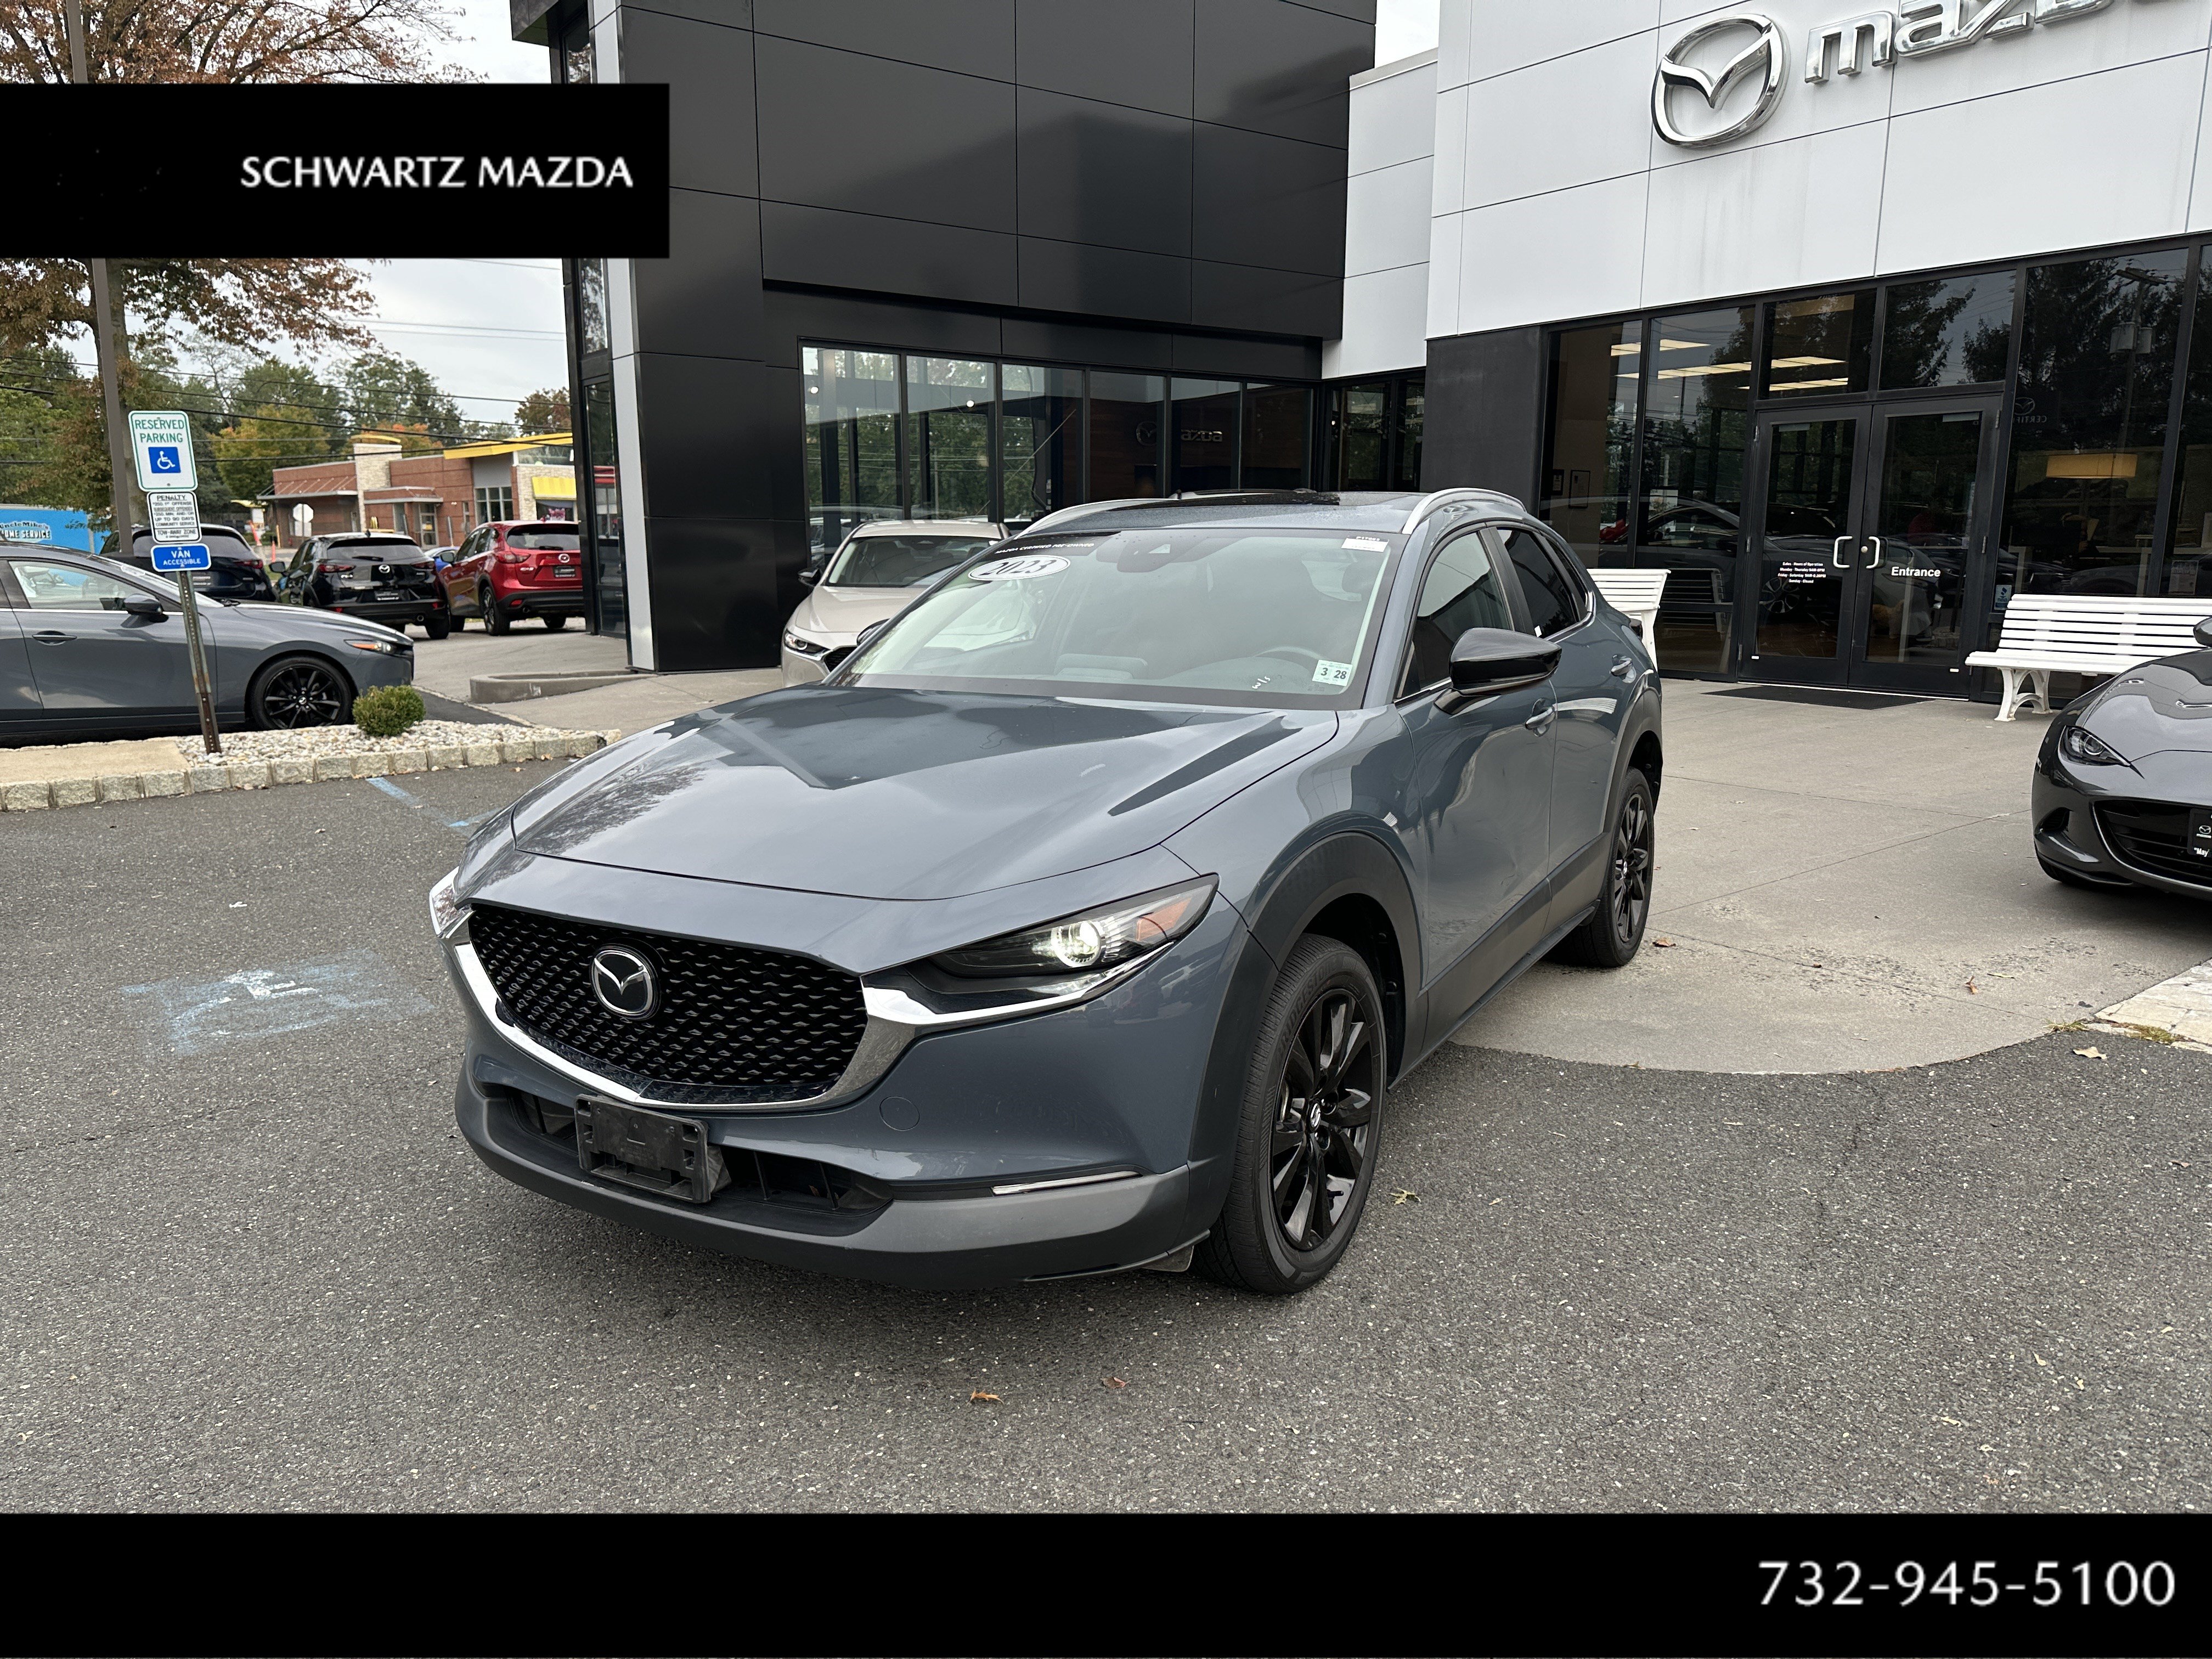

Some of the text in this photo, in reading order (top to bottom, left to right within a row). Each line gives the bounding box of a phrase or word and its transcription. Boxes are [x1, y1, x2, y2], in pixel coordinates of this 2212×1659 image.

[134, 420, 184, 429] RESERVED
[140, 433, 183, 443] PARKING
[1181, 430, 1223, 442] azda
[21, 529, 50, 538] SERVICE
[171, 550, 190, 558] VAN
[978, 560, 1057, 576] 2023
[1891, 566, 1941, 577] Entrance
[1321, 668, 1347, 679] 3 28
